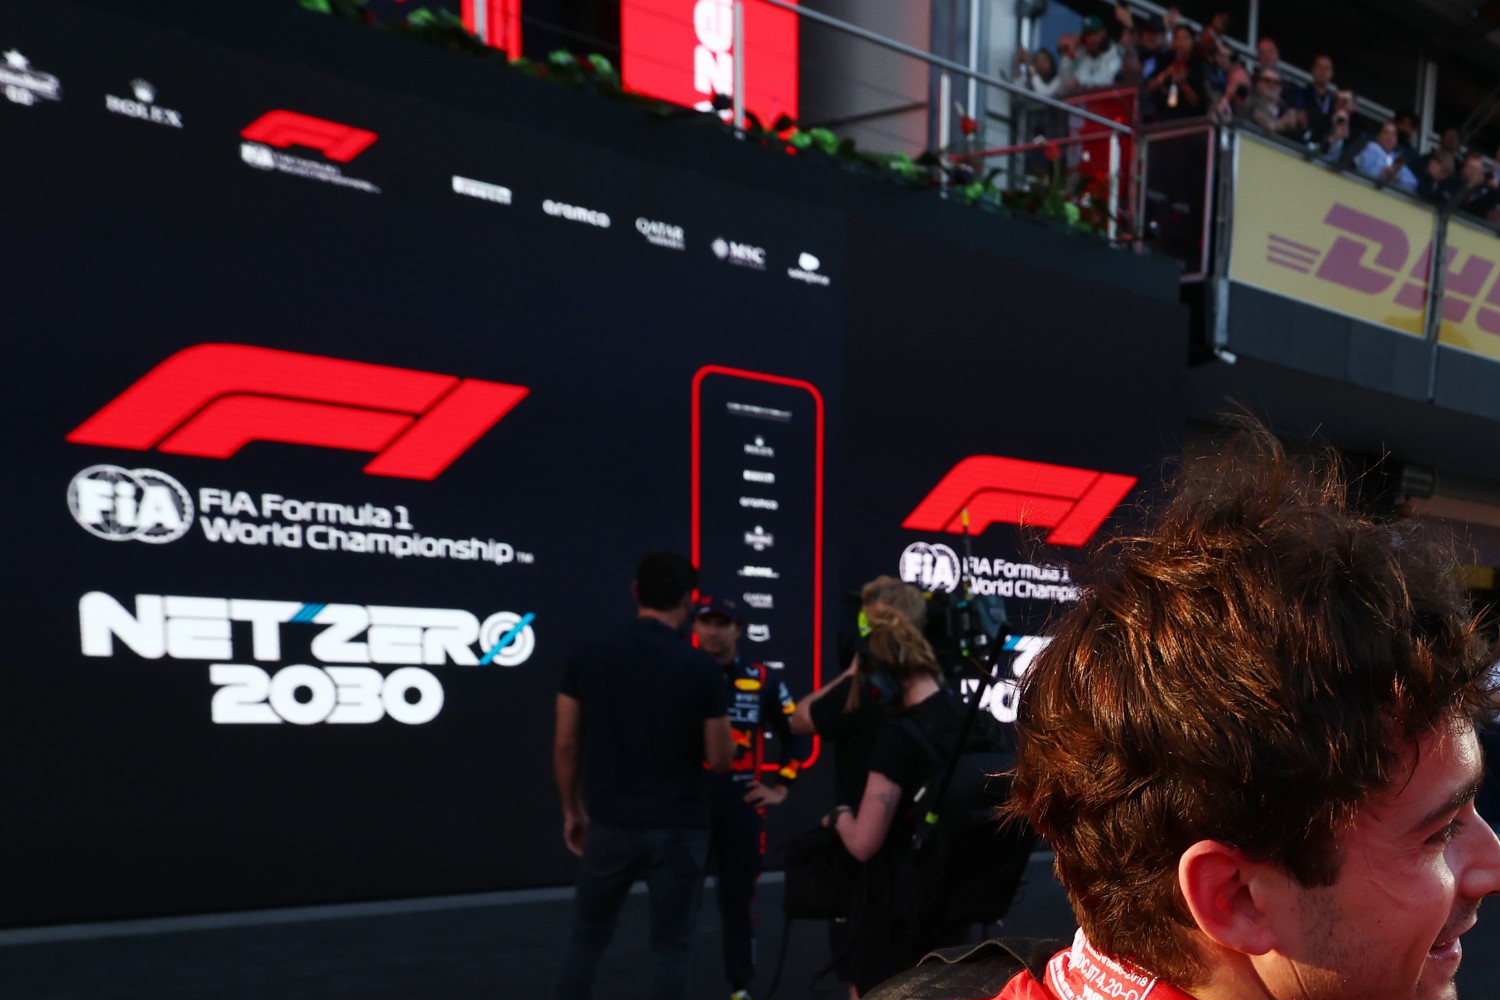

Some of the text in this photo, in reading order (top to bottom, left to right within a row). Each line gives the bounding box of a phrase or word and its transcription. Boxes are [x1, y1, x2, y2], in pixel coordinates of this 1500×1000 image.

[105, 93, 184, 128] ROLEX
[542, 200, 611, 228] aramco
[76, 478, 183, 528] FIA
[200, 487, 414, 531] FIA Formula 1
[200, 516, 301, 549] World
[305, 522, 514, 565] Championship
[902, 551, 955, 587] FIA
[1014, 580, 1083, 603] Champ
[79, 591, 294, 661] NET
[209, 664, 444, 724] 2030
